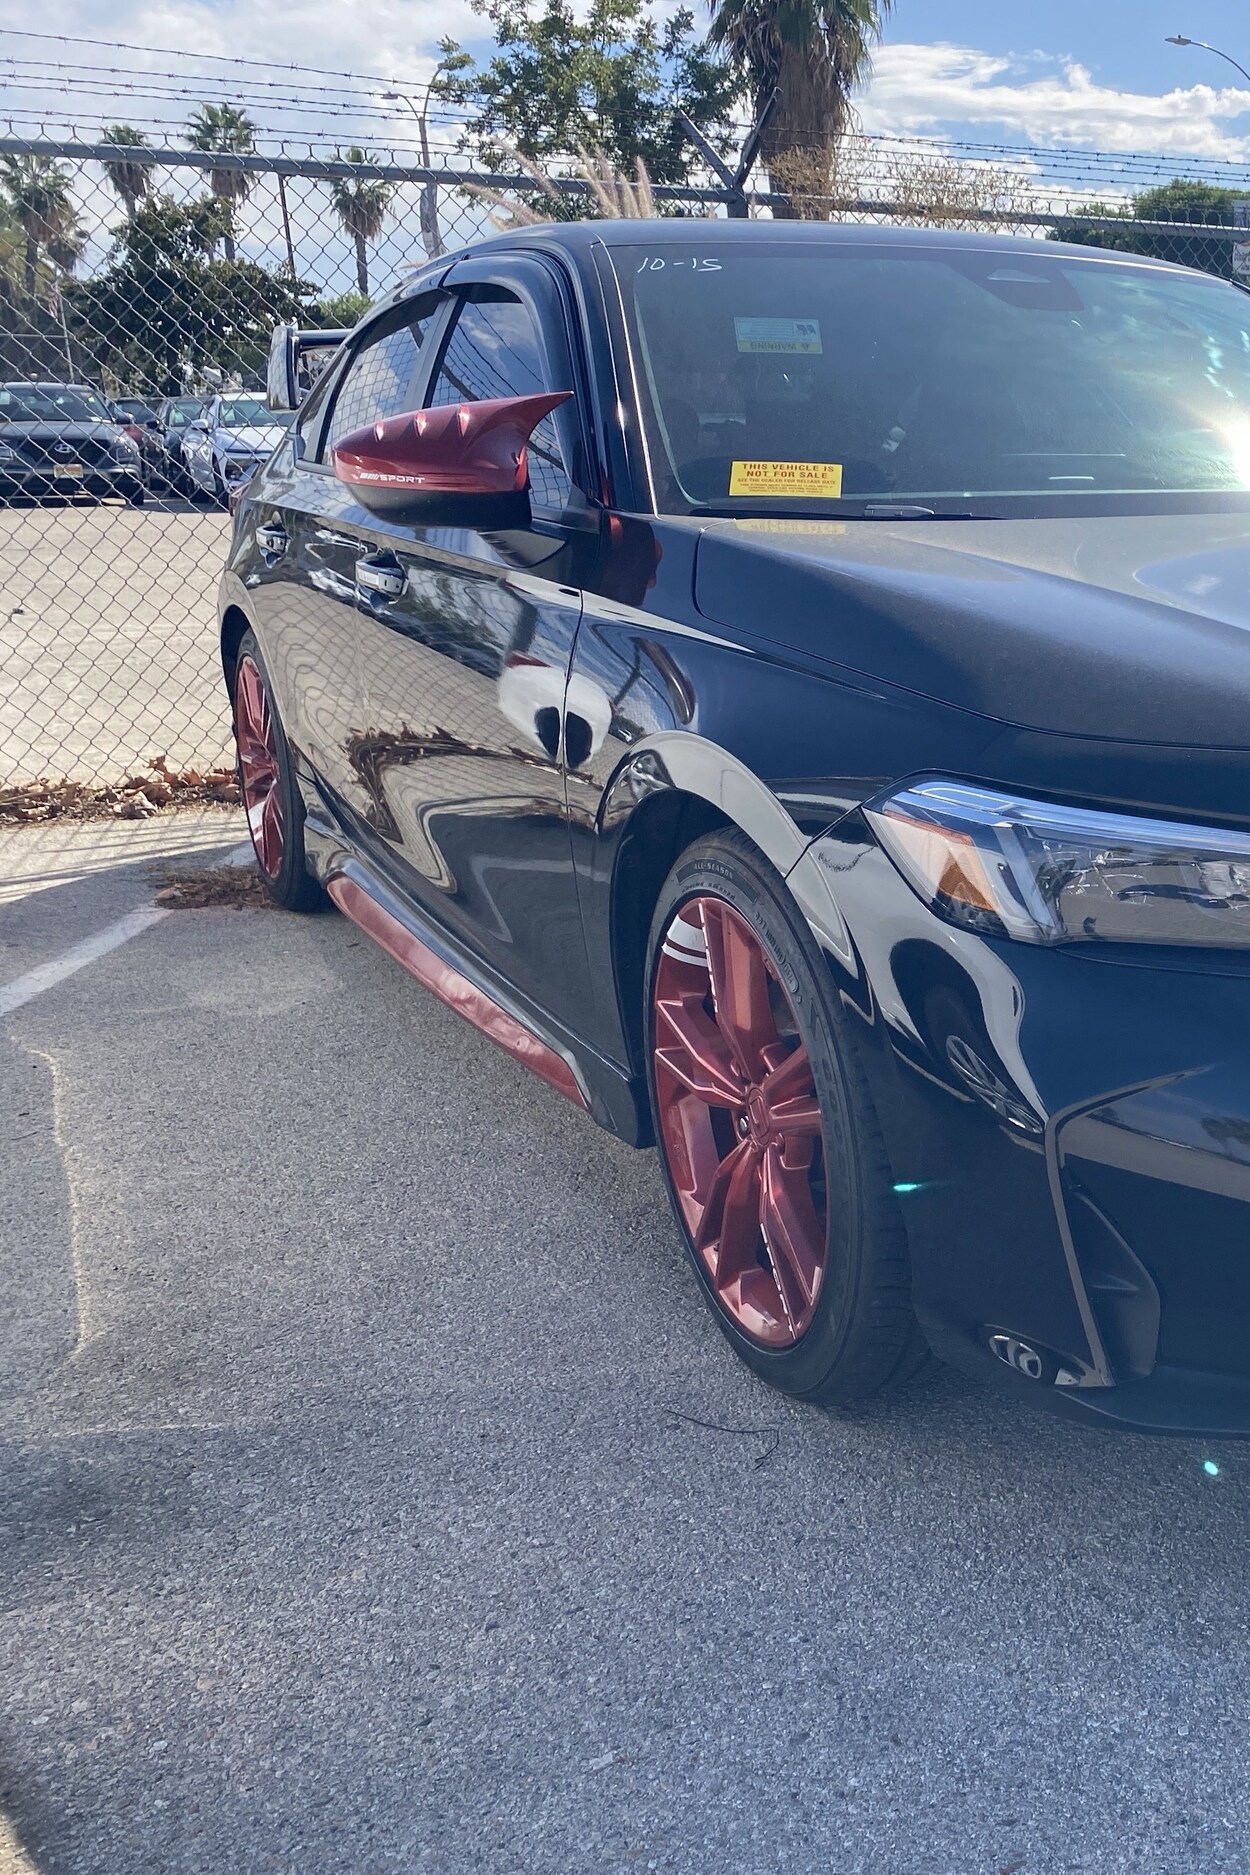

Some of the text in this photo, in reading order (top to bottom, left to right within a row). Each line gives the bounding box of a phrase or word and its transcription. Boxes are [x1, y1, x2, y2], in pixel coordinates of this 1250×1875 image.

[772, 464, 819, 472] VEHICLE
[379, 474, 426, 484] SPORT
[746, 470, 770, 478] NOT
[799, 471, 828, 479] SALE
[694, 862, 734, 879] ALL-SEASON
